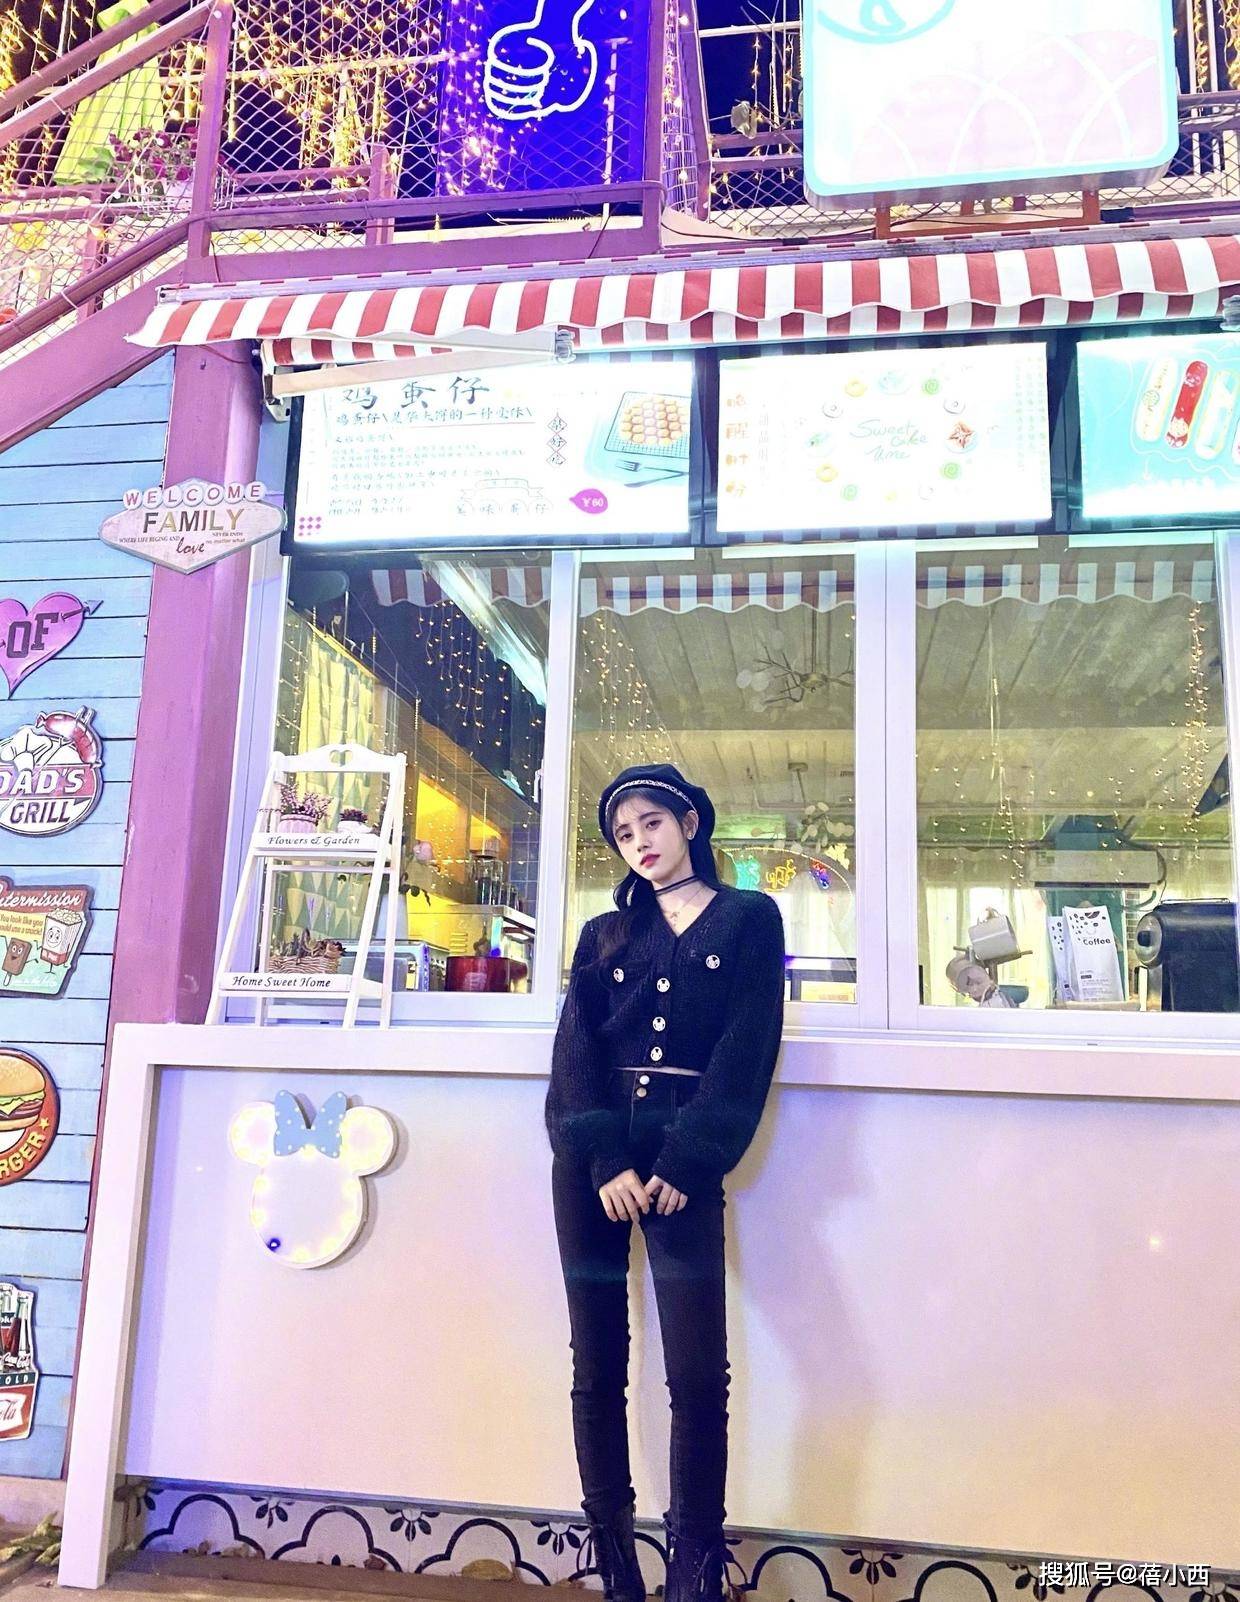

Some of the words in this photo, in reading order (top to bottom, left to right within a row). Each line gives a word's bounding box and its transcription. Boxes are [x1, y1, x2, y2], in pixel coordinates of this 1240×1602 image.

[849, 418, 917, 439] Sweet
[125, 485, 262, 505] WELCOME
[142, 508, 245, 534] FAMILY
[176, 537, 205, 554] love
[6, 612, 60, 660] OF
[10, 800, 72, 824] GRILL
[268, 836, 309, 846] Flowers
[310, 836, 321, 846] &
[322, 836, 361, 846] Garden
[0, 883, 82, 908] termission
[1082, 937, 1112, 947] Coffee
[232, 976, 263, 986] Home
[264, 976, 298, 988] Sweet
[299, 978, 332, 988] Home
[0, 1375, 29, 1386] OLD
